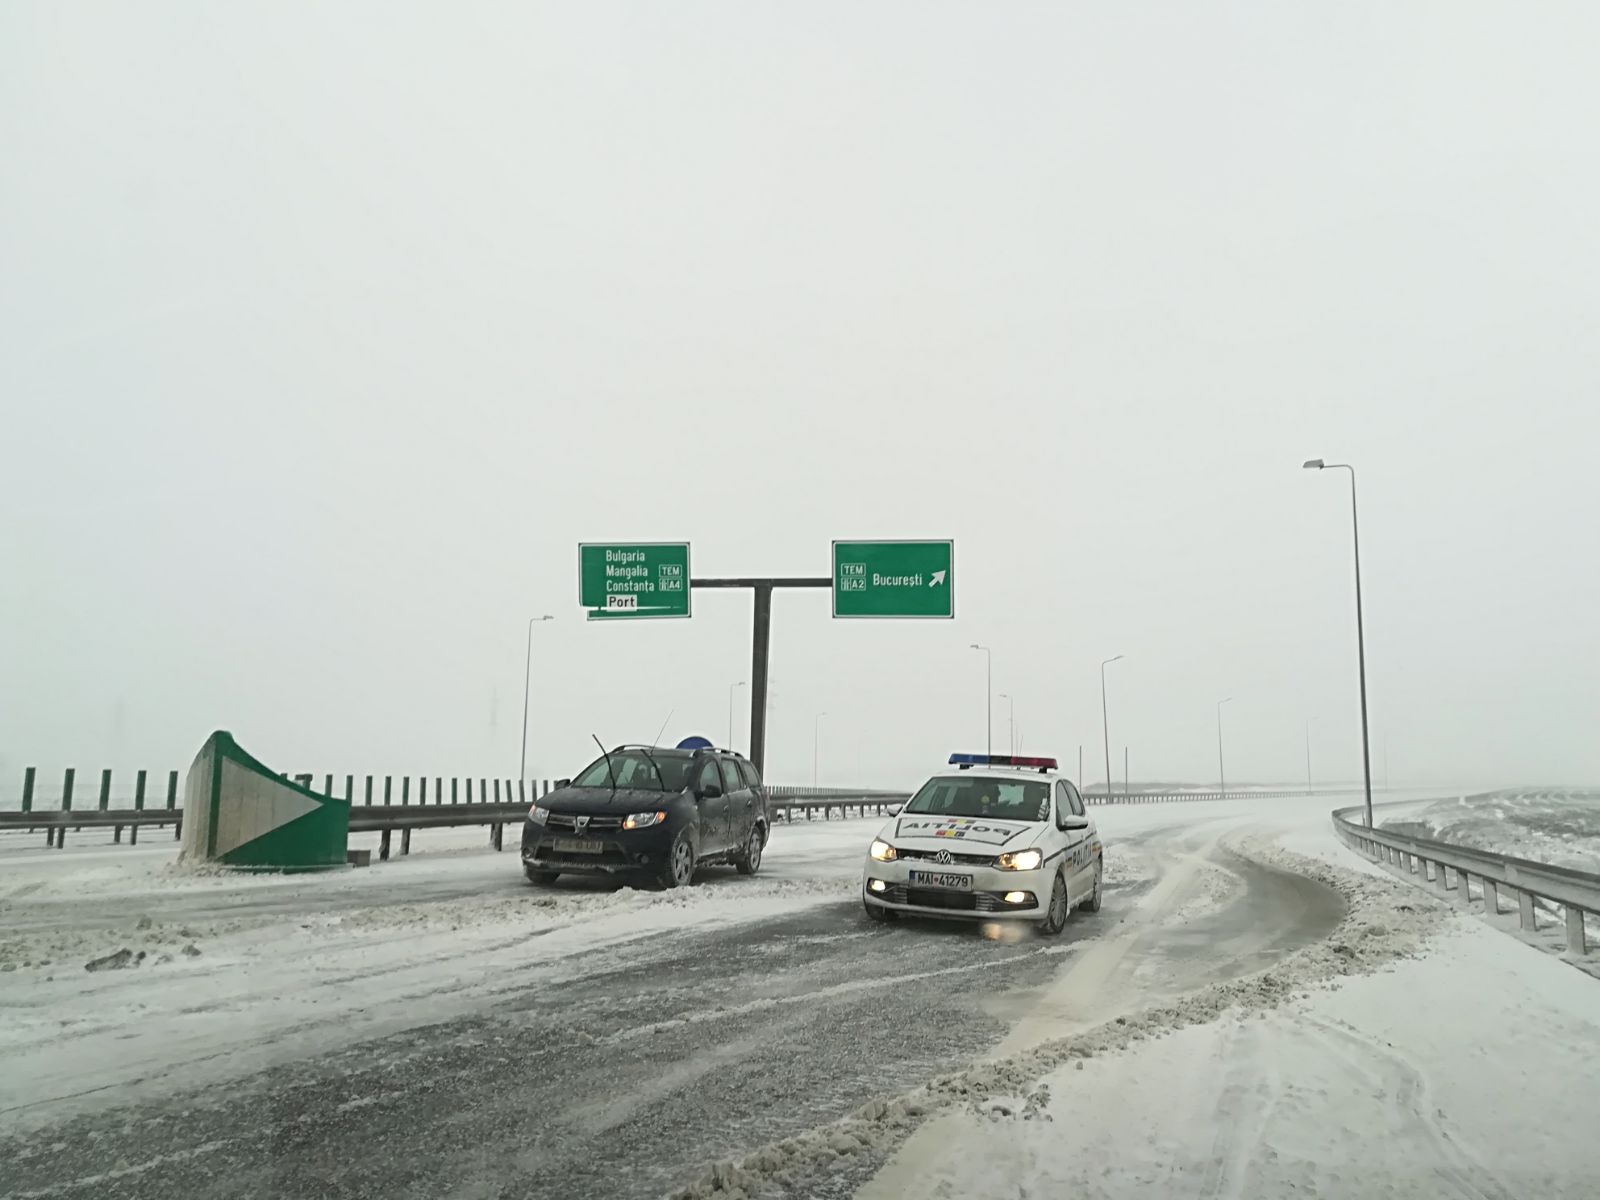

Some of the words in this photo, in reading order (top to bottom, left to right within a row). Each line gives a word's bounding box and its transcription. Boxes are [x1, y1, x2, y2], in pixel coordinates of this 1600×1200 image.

[606, 550, 645, 564] Bulgaria
[606, 565, 648, 579] Mangalia
[662, 567, 679, 575] TEM
[844, 565, 863, 574] TEM
[668, 580, 680, 589] A4
[852, 579, 864, 588] A2
[609, 596, 635, 607] Port
[918, 872, 933, 885] MAI
[939, 874, 968, 887] 41279
